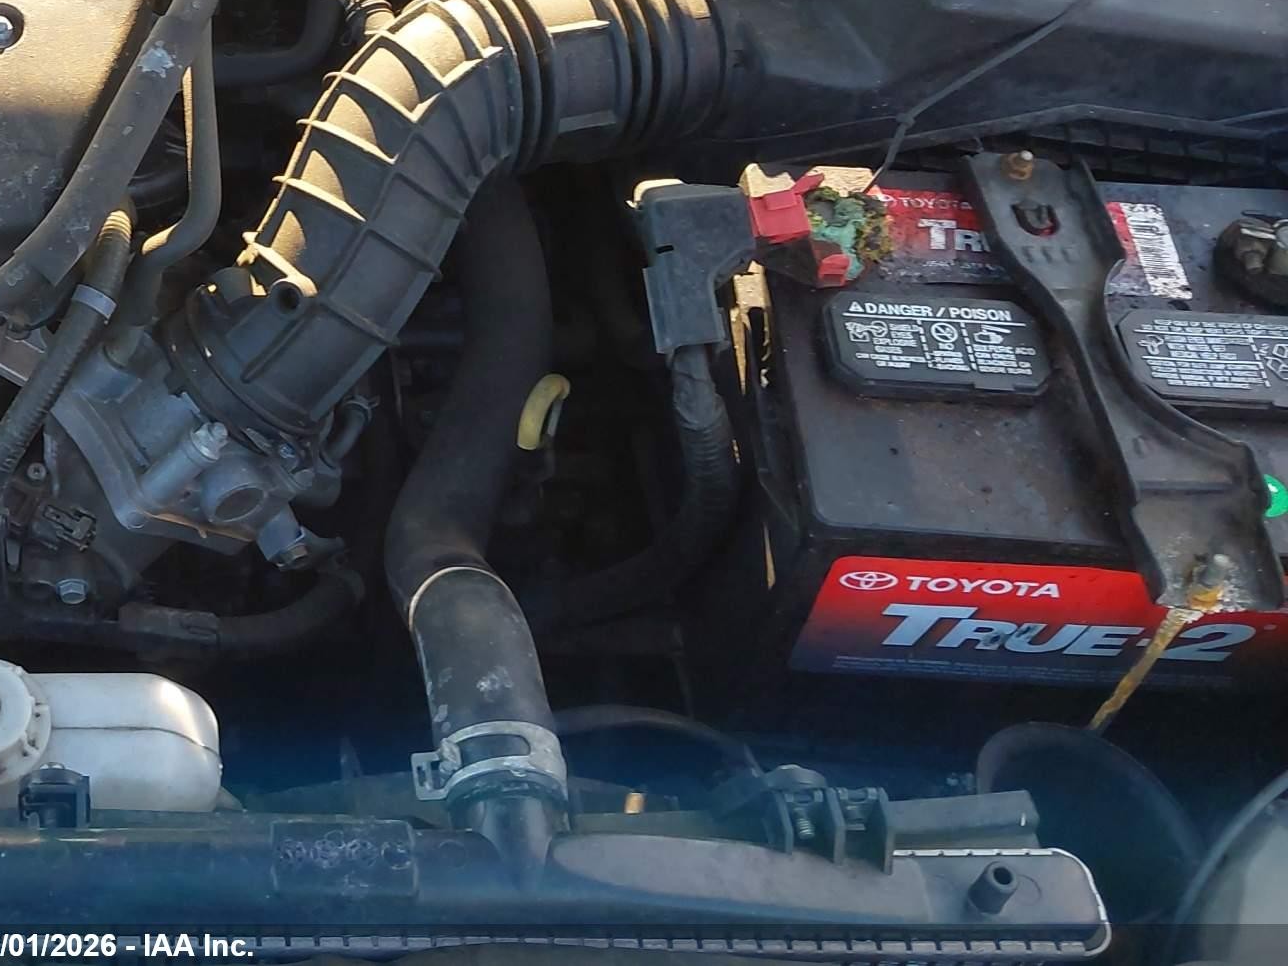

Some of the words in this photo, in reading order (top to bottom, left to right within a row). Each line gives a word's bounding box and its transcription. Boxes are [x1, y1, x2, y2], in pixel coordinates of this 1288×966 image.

[900, 197, 973, 210] TOYOTA
[864, 302, 933, 317] DANGER
[949, 307, 1012, 321] POISON
[905, 576, 1061, 598] TOYOTA
